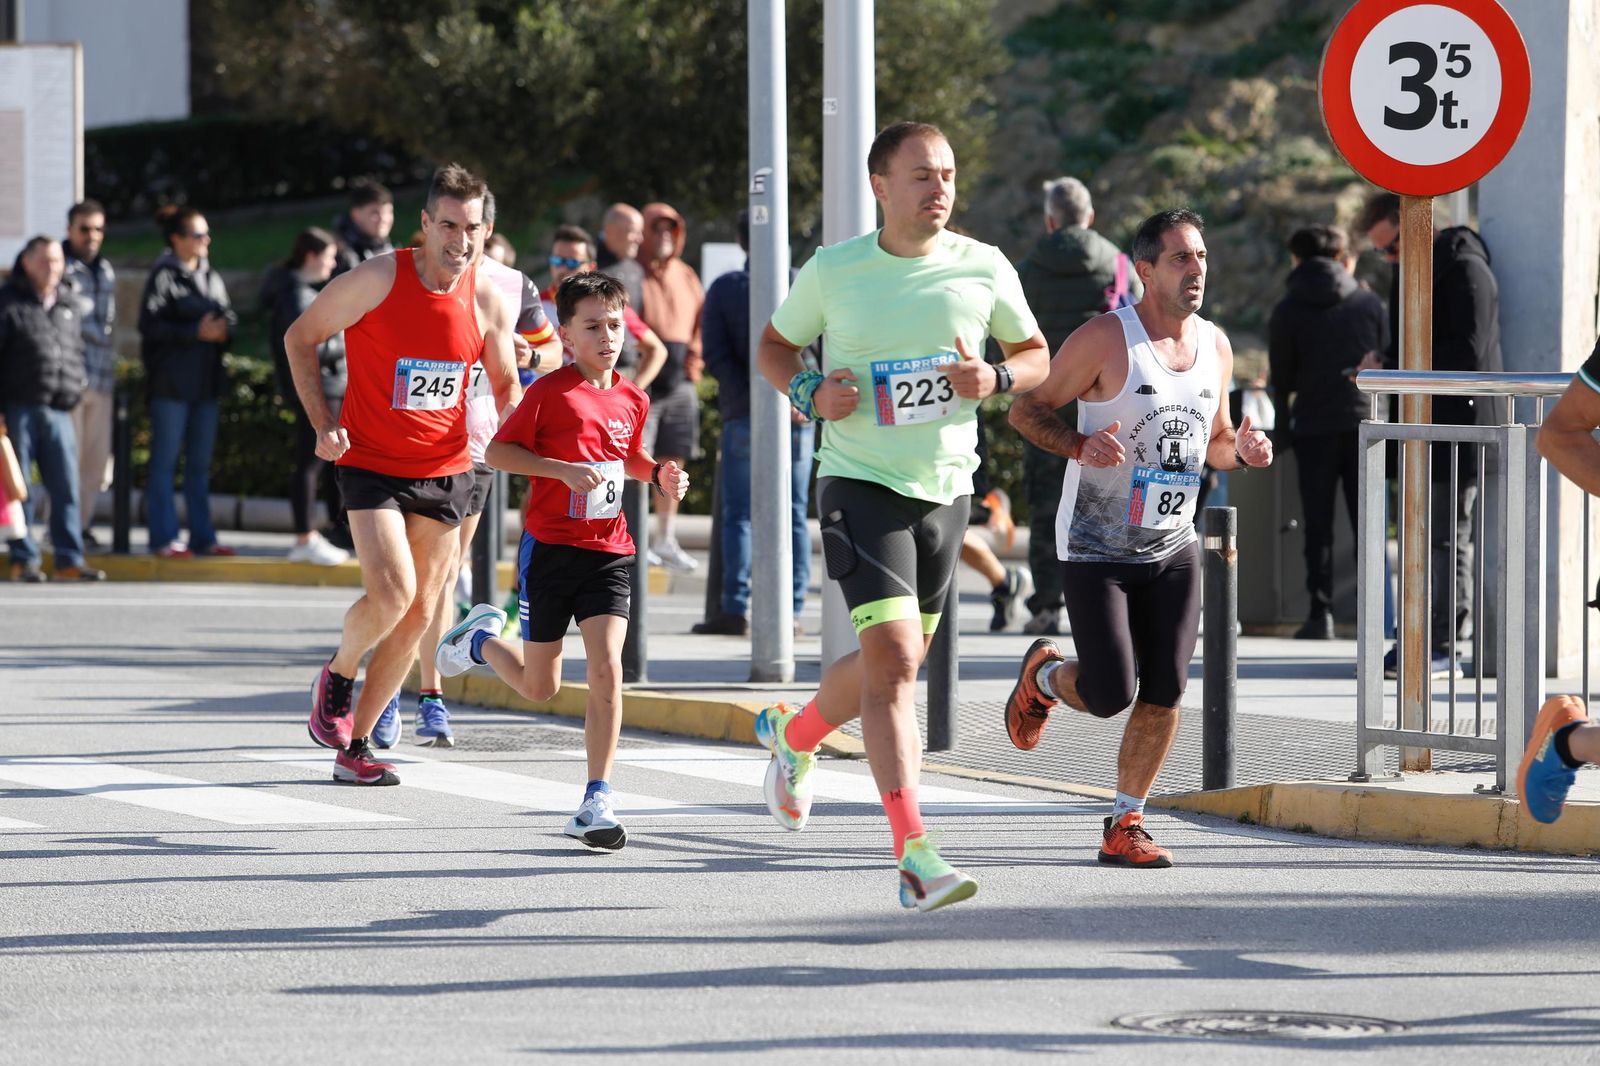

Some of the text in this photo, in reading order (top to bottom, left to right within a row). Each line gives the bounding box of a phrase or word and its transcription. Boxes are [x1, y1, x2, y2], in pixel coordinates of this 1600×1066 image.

[400, 359, 464, 370] III CARRERA
[876, 363, 889, 372] III
[893, 354, 957, 371] CARRERA
[411, 375, 456, 397] 245
[896, 376, 954, 409] 223
[1129, 418, 1146, 441] XXIV
[1146, 404, 1188, 421] CARRERA
[1133, 479, 1146, 489] SAN
[1137, 469, 1200, 483] III CARRERA
[605, 480, 616, 504] 8
[1157, 491, 1186, 516] 82
